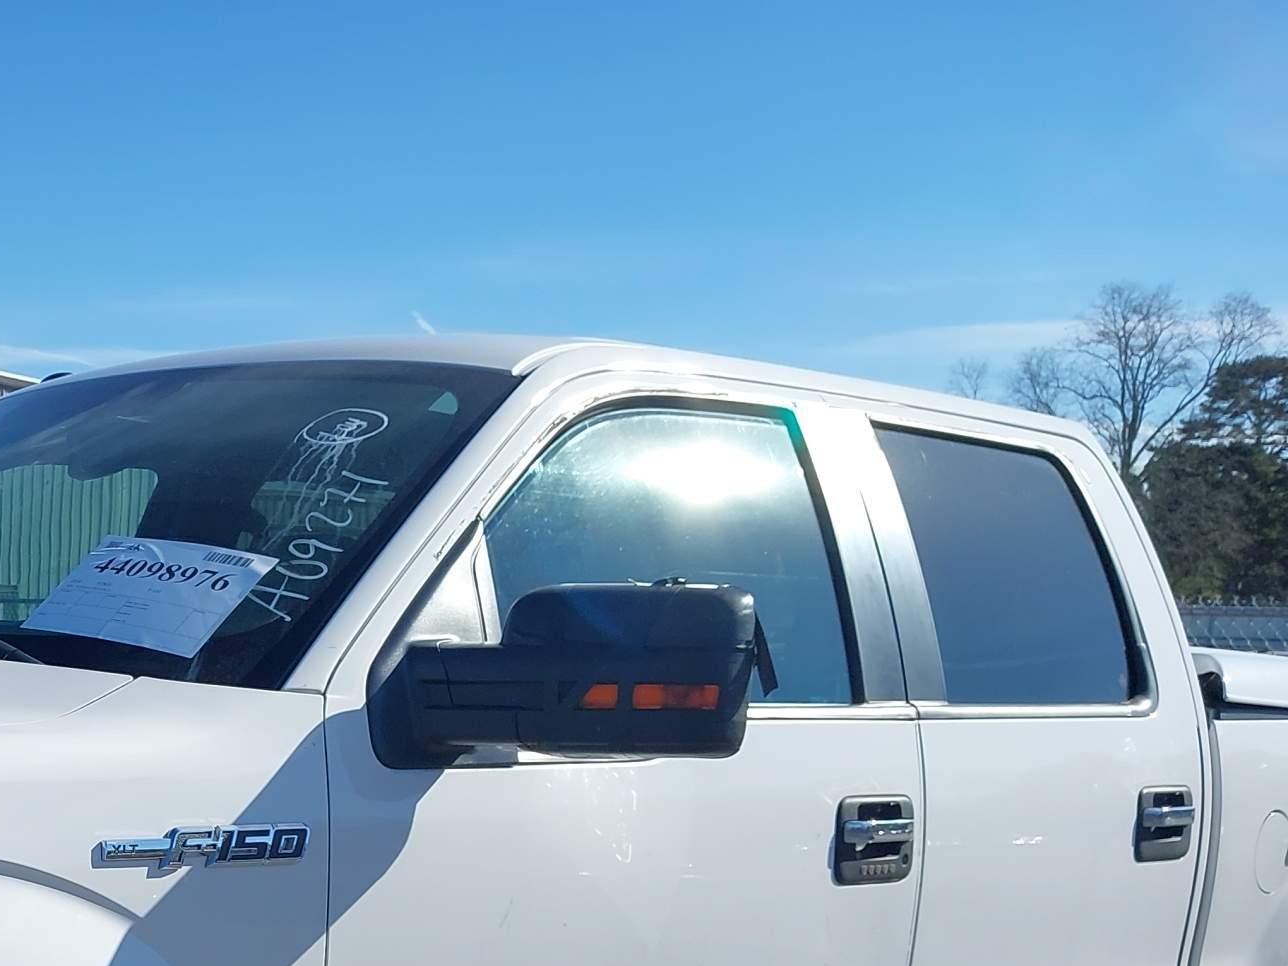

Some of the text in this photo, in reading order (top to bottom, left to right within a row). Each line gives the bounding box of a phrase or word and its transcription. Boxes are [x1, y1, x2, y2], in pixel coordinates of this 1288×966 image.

[94, 556, 239, 592] 44098976
[112, 843, 139, 855] XLT
[159, 823, 310, 870] F-150
